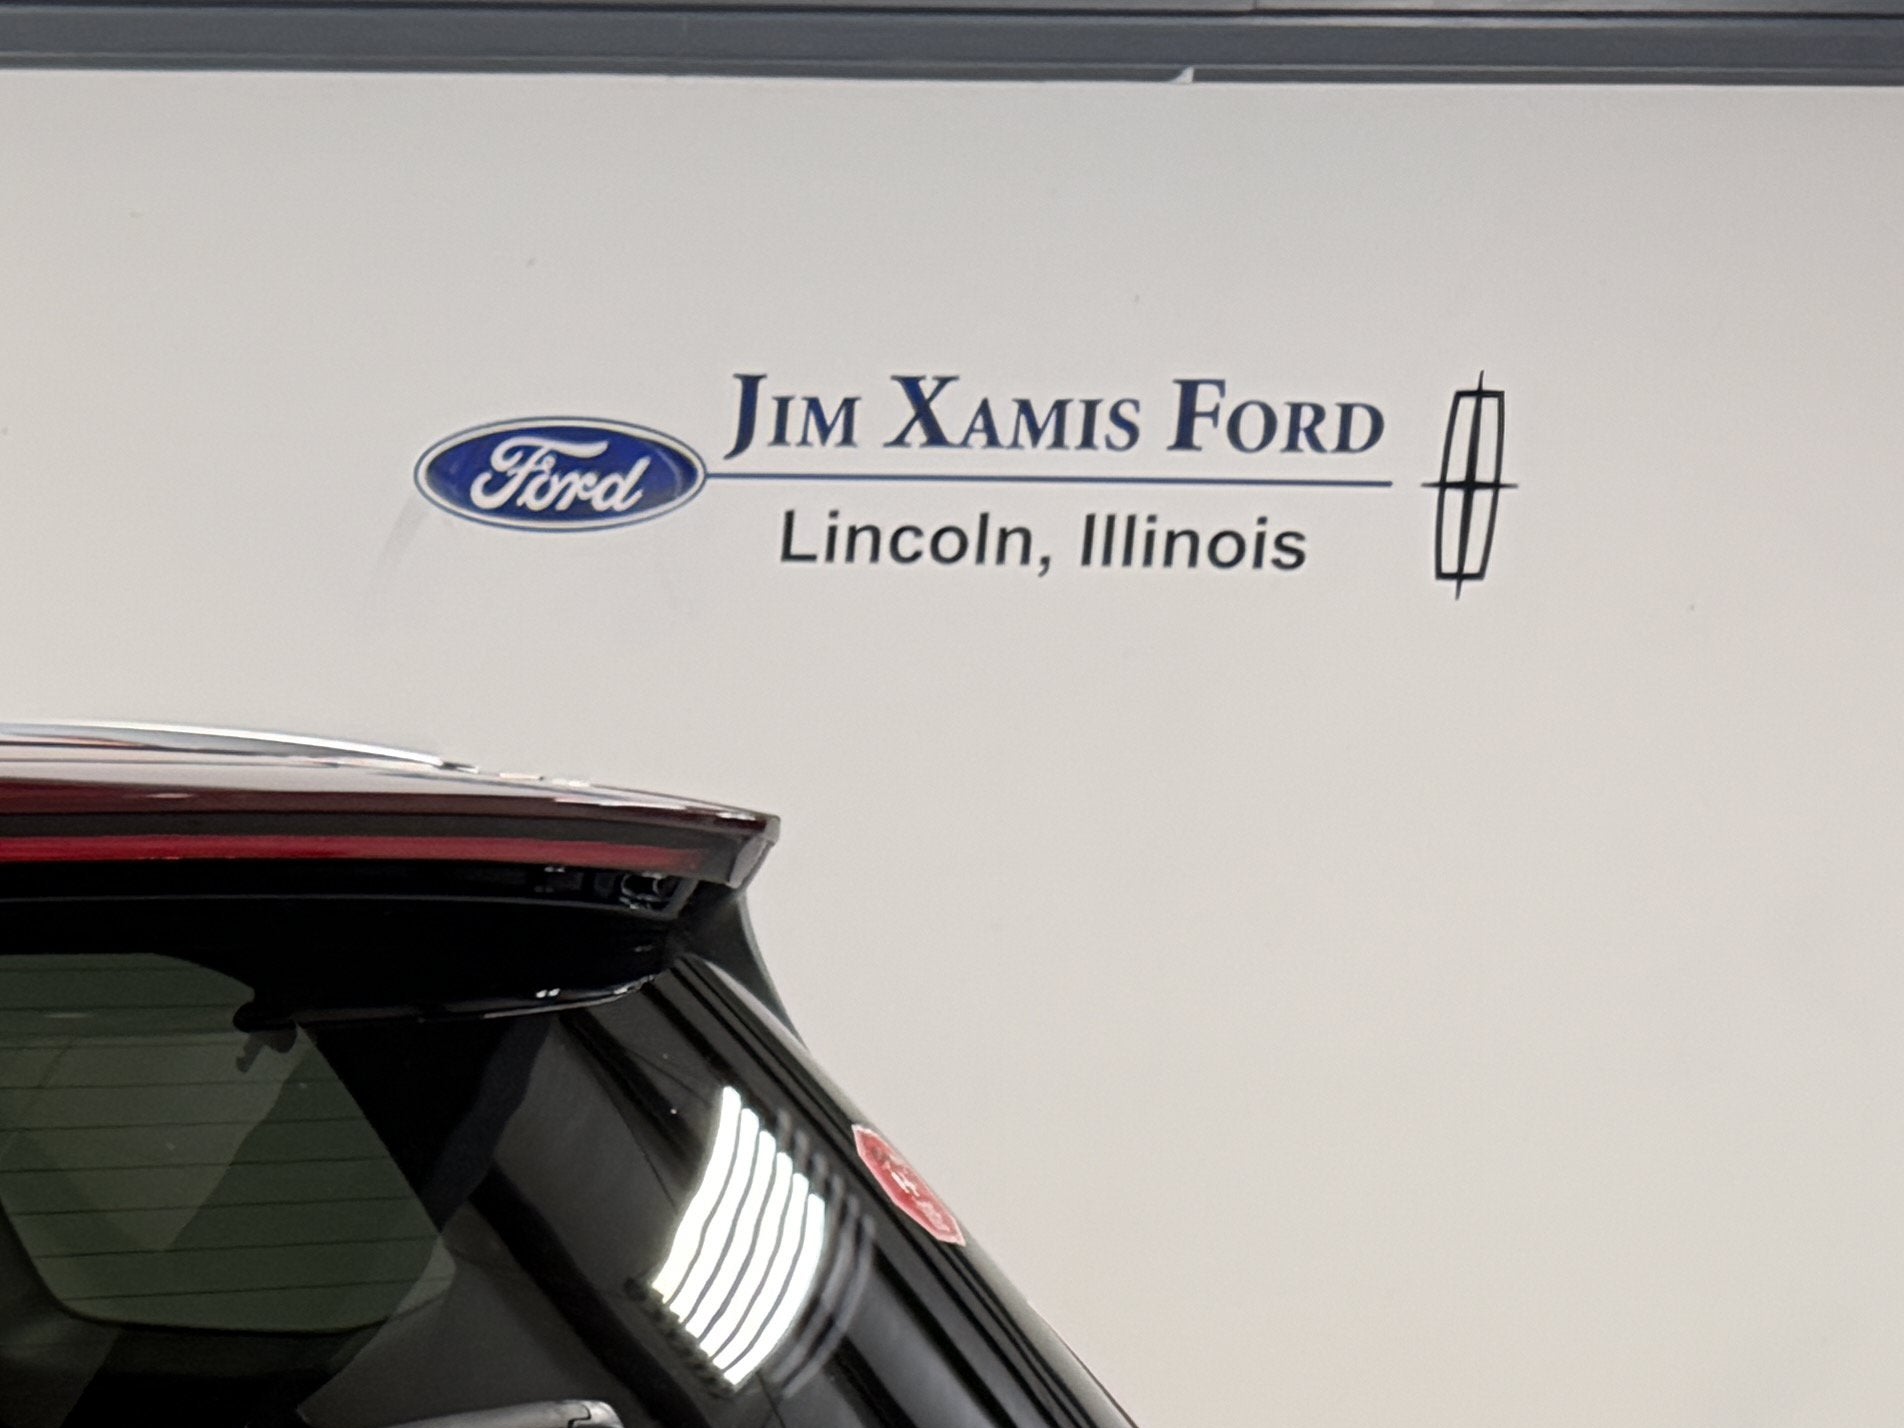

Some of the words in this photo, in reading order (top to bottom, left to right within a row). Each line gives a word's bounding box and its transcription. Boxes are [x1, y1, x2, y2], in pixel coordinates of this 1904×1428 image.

[723, 373, 862, 460] JIM
[883, 375, 1141, 452] XAMIS
[1167, 379, 1385, 454] FORD
[470, 436, 651, 512] Ford
[781, 509, 1051, 578] Lincoln,
[1081, 513, 1307, 571] Illinois
